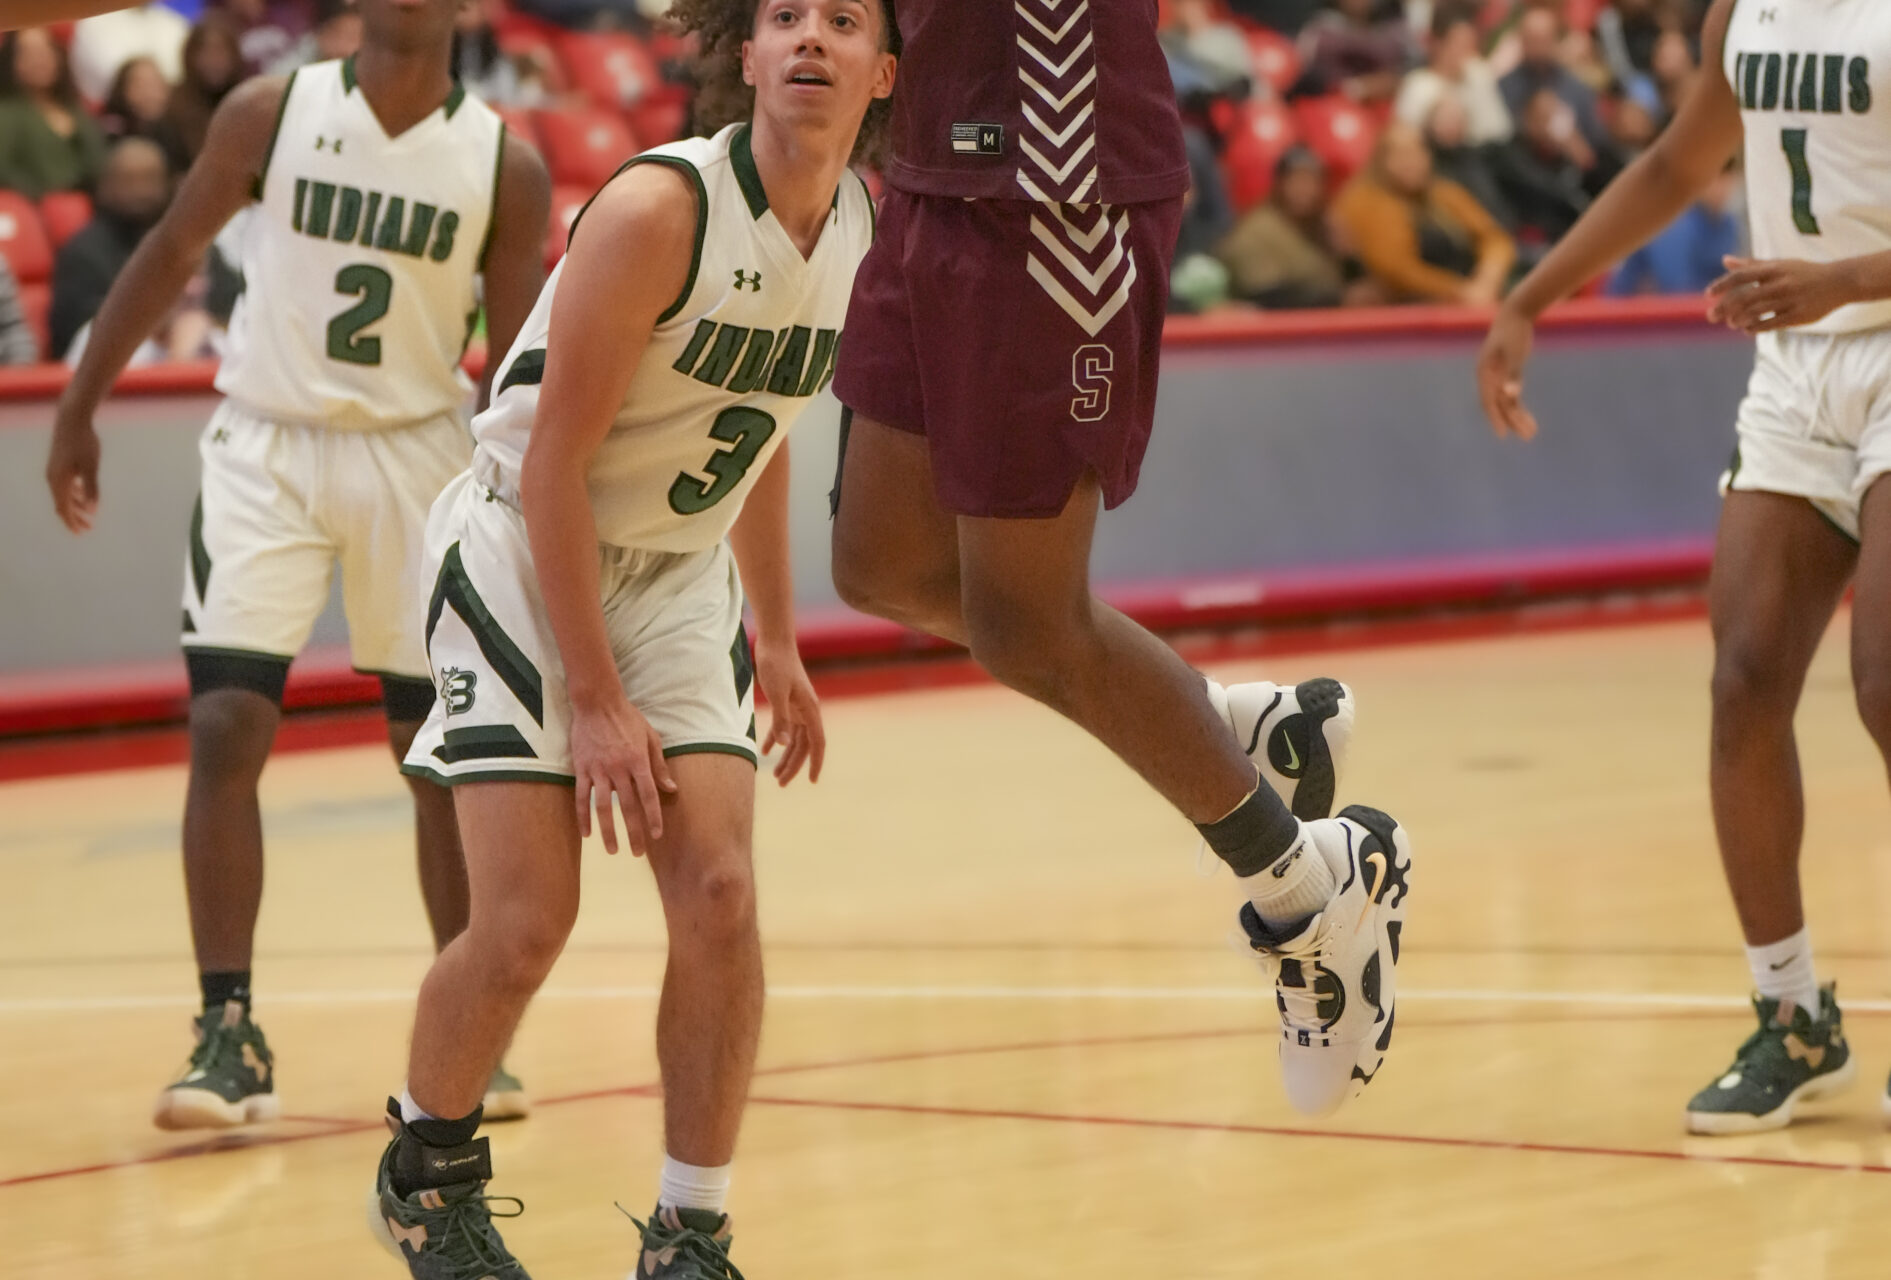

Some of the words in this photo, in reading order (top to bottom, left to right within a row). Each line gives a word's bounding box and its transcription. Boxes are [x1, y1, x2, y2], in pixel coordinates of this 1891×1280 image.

[983, 132, 994, 146] M
[1780, 128, 1821, 237] 1
[291, 178, 460, 263] INDIANS
[326, 263, 393, 366] 2
[1070, 344, 1114, 422] S
[667, 405, 777, 516] 3
